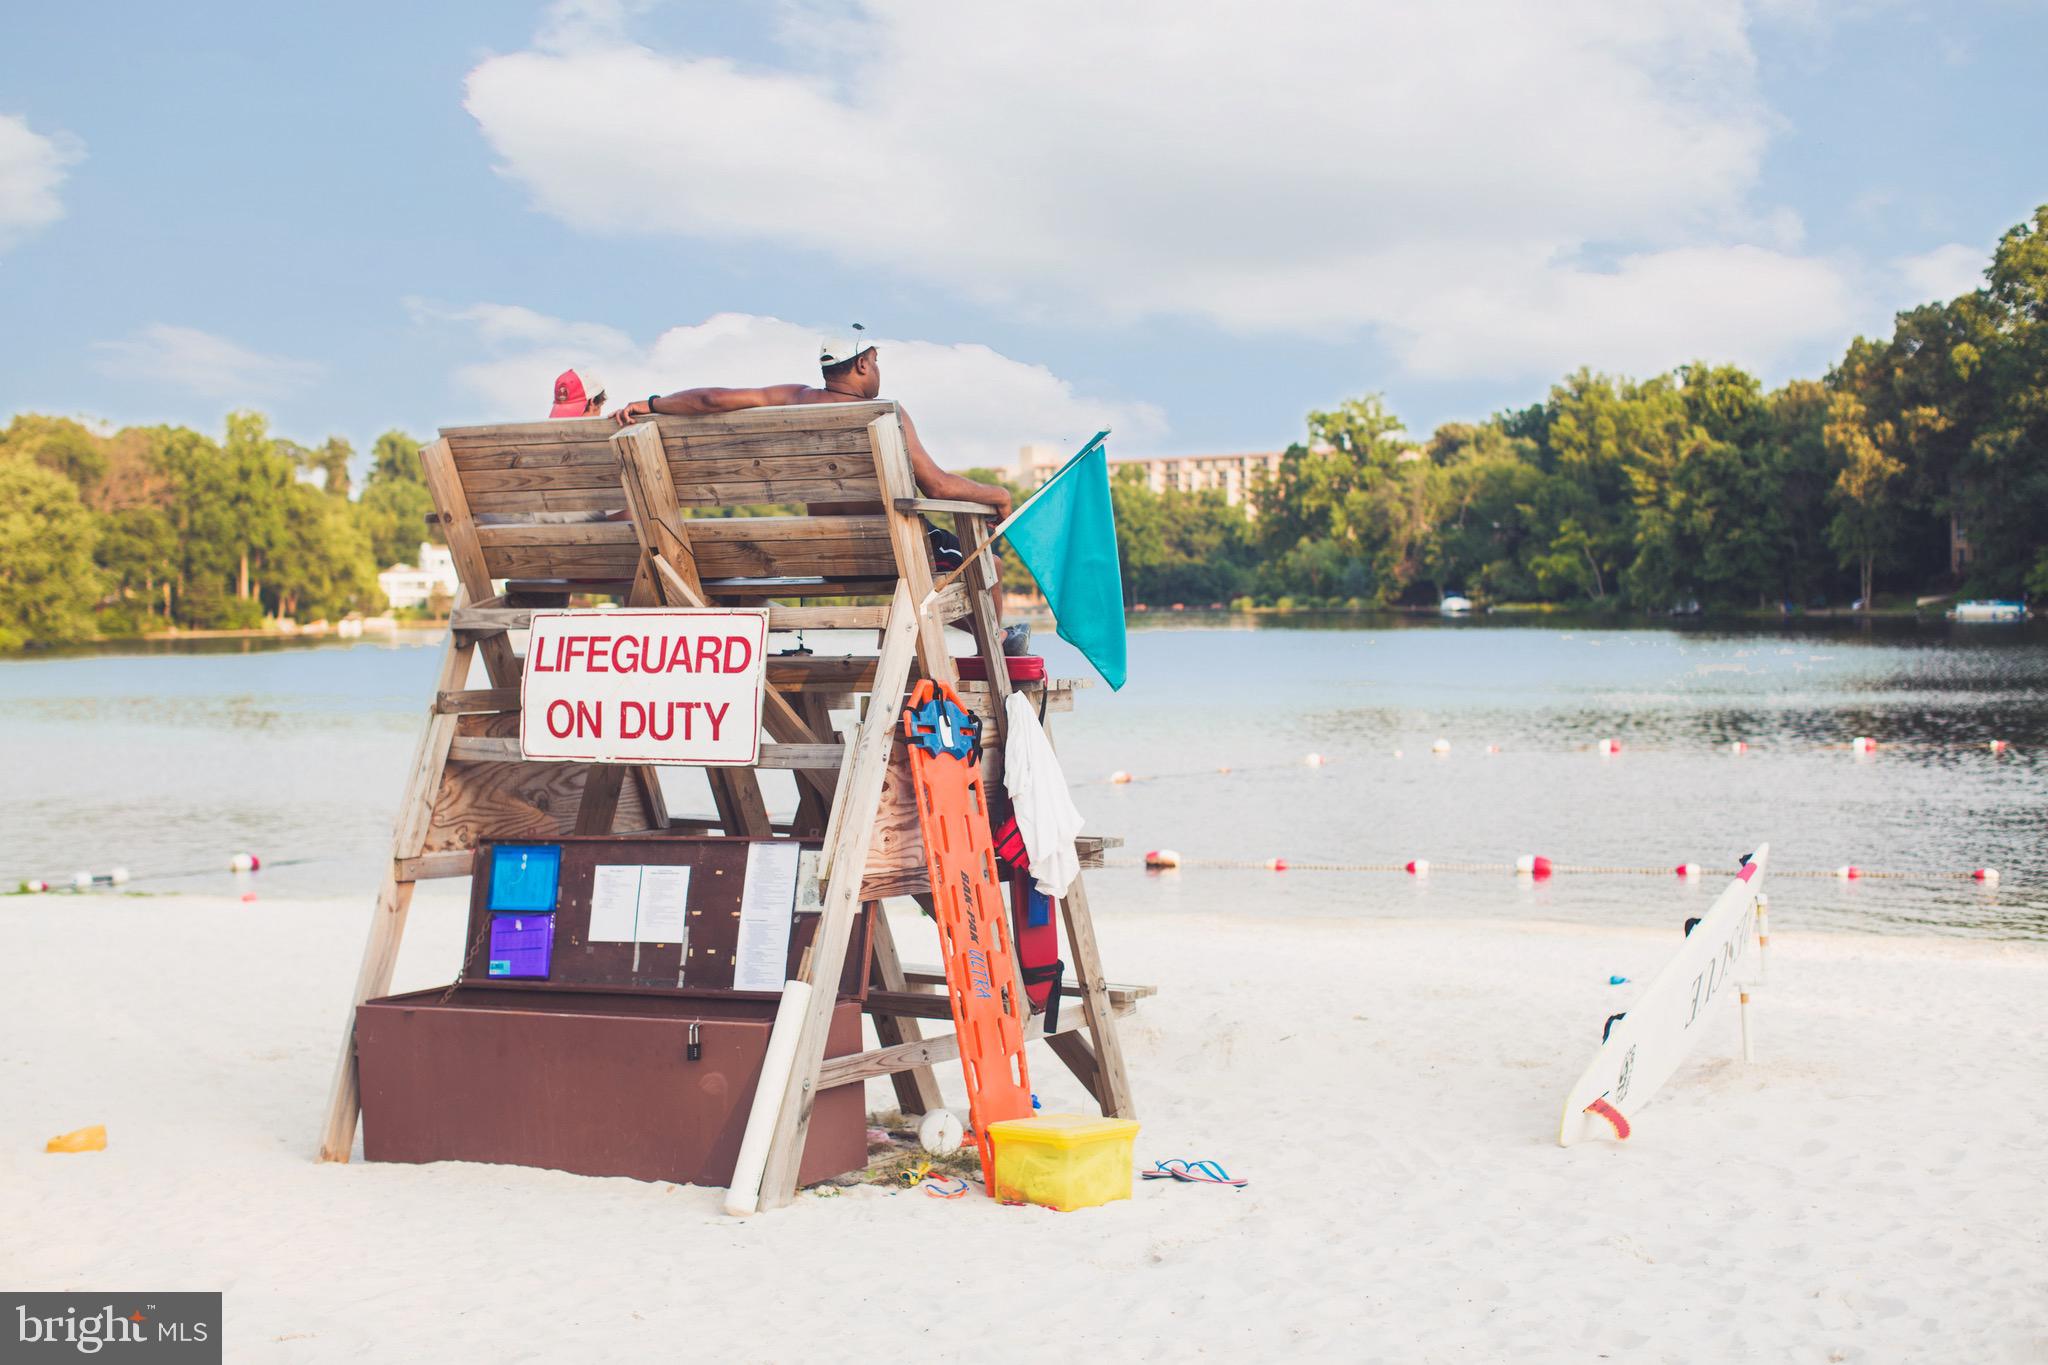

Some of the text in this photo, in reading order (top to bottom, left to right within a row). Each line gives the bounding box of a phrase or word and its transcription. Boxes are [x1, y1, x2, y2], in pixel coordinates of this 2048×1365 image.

[534, 635, 752, 674] LIFEGUARD
[546, 699, 730, 741] ON DUTY
[961, 870, 991, 998] BAK-PAK ULTRA
